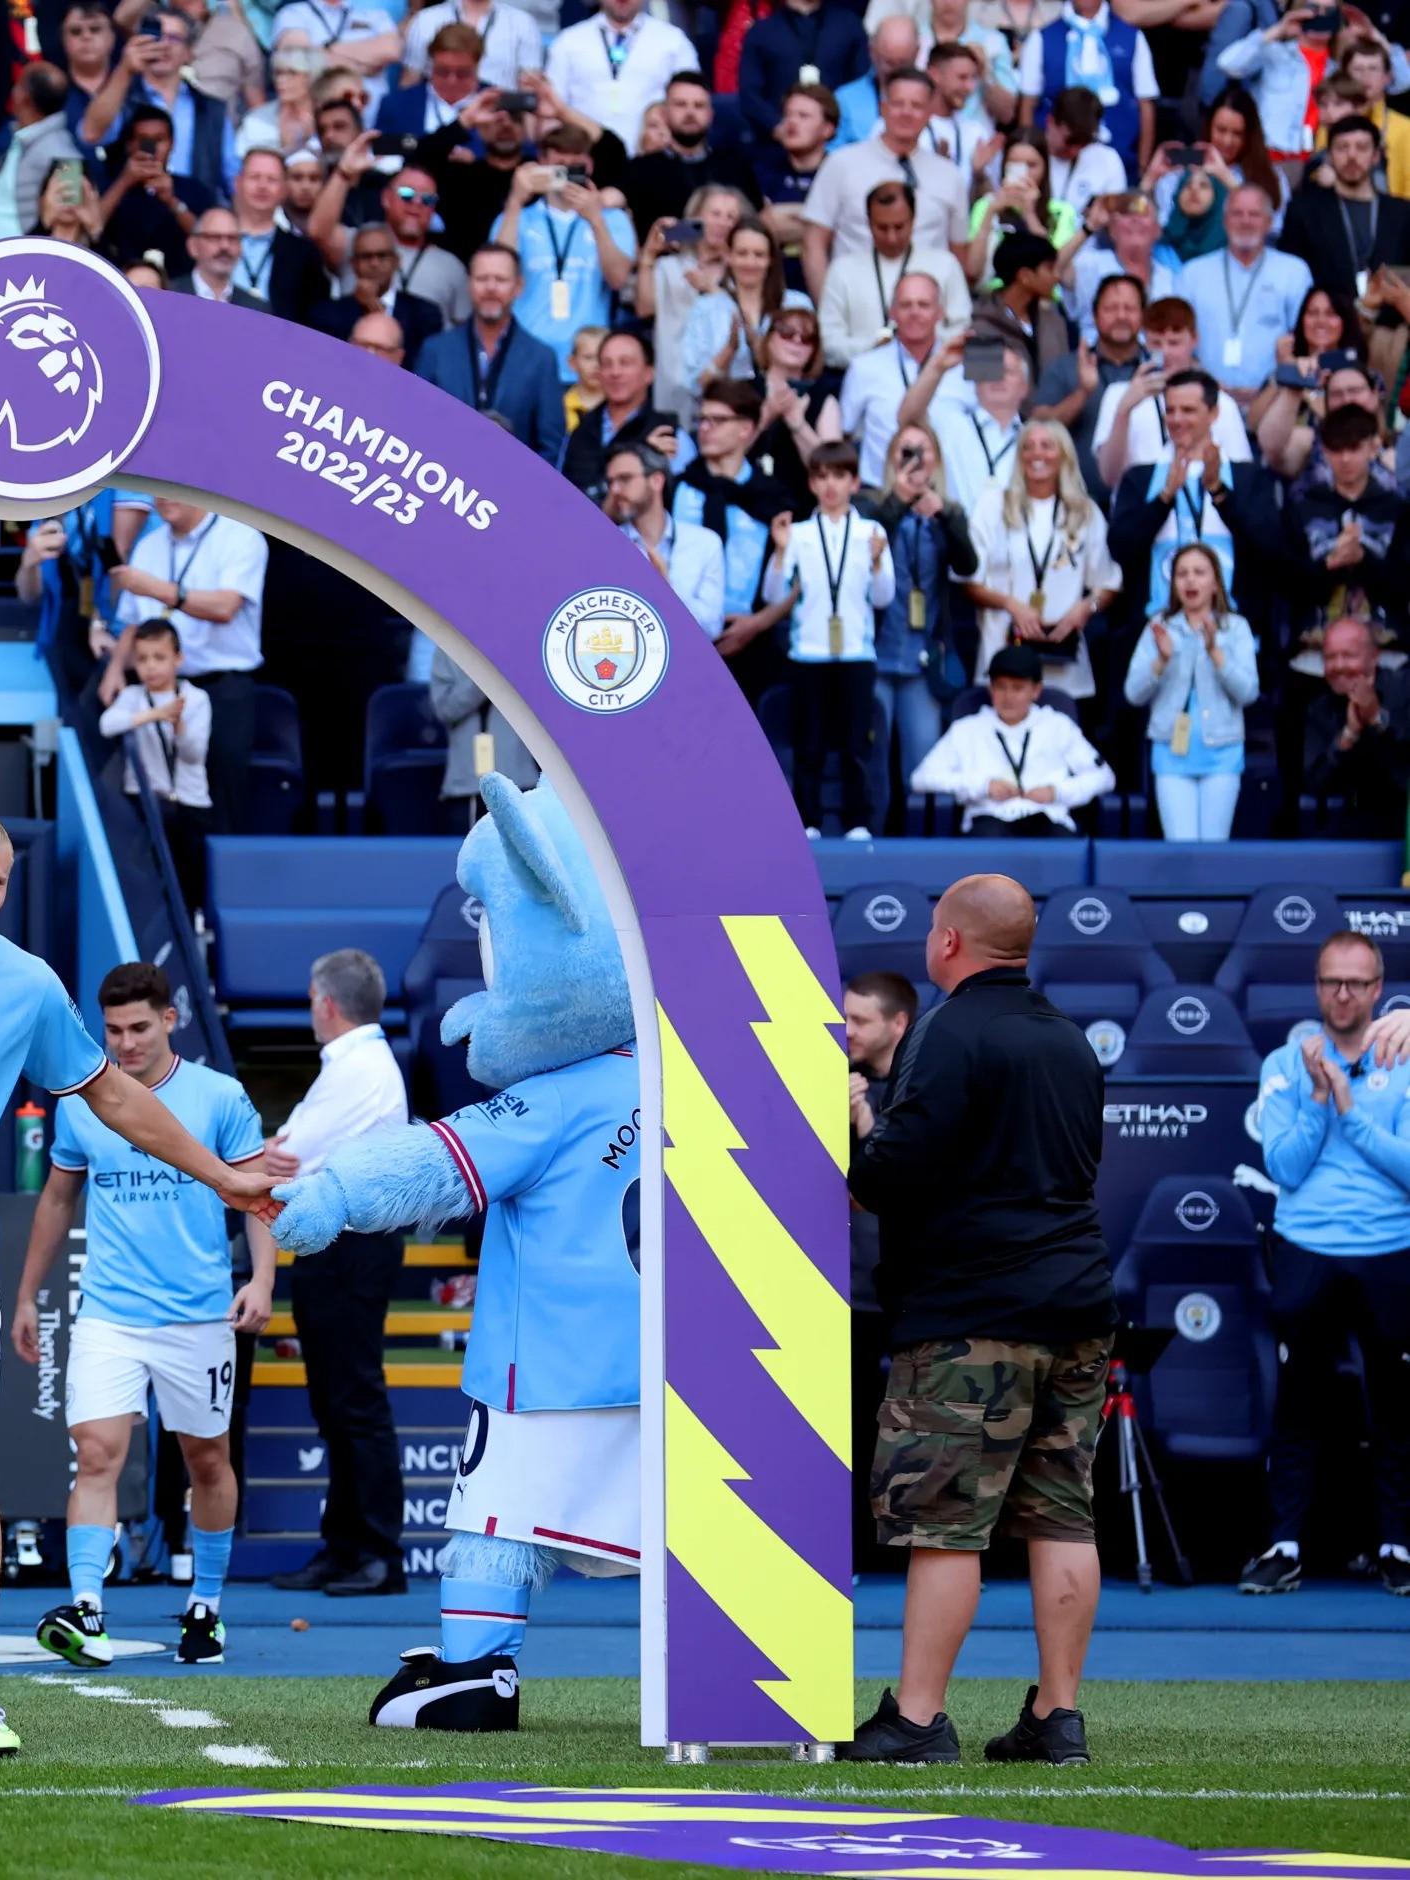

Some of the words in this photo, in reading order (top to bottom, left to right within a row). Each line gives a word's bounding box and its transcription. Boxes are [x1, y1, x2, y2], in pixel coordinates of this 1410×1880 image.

[262, 380, 499, 530] CHAMPIONS
[276, 431, 425, 525] 2022/23
[555, 595, 656, 634] MANCHESTER
[588, 694, 625, 705] CITY
[1102, 1104, 1208, 1123] ETIHAD
[1118, 1124, 1189, 1138] AIRWAYS
[112, 1189, 180, 1204] AIRWAYS
[32, 1308, 61, 1421] Therabody
[207, 1360, 232, 1405] 19
